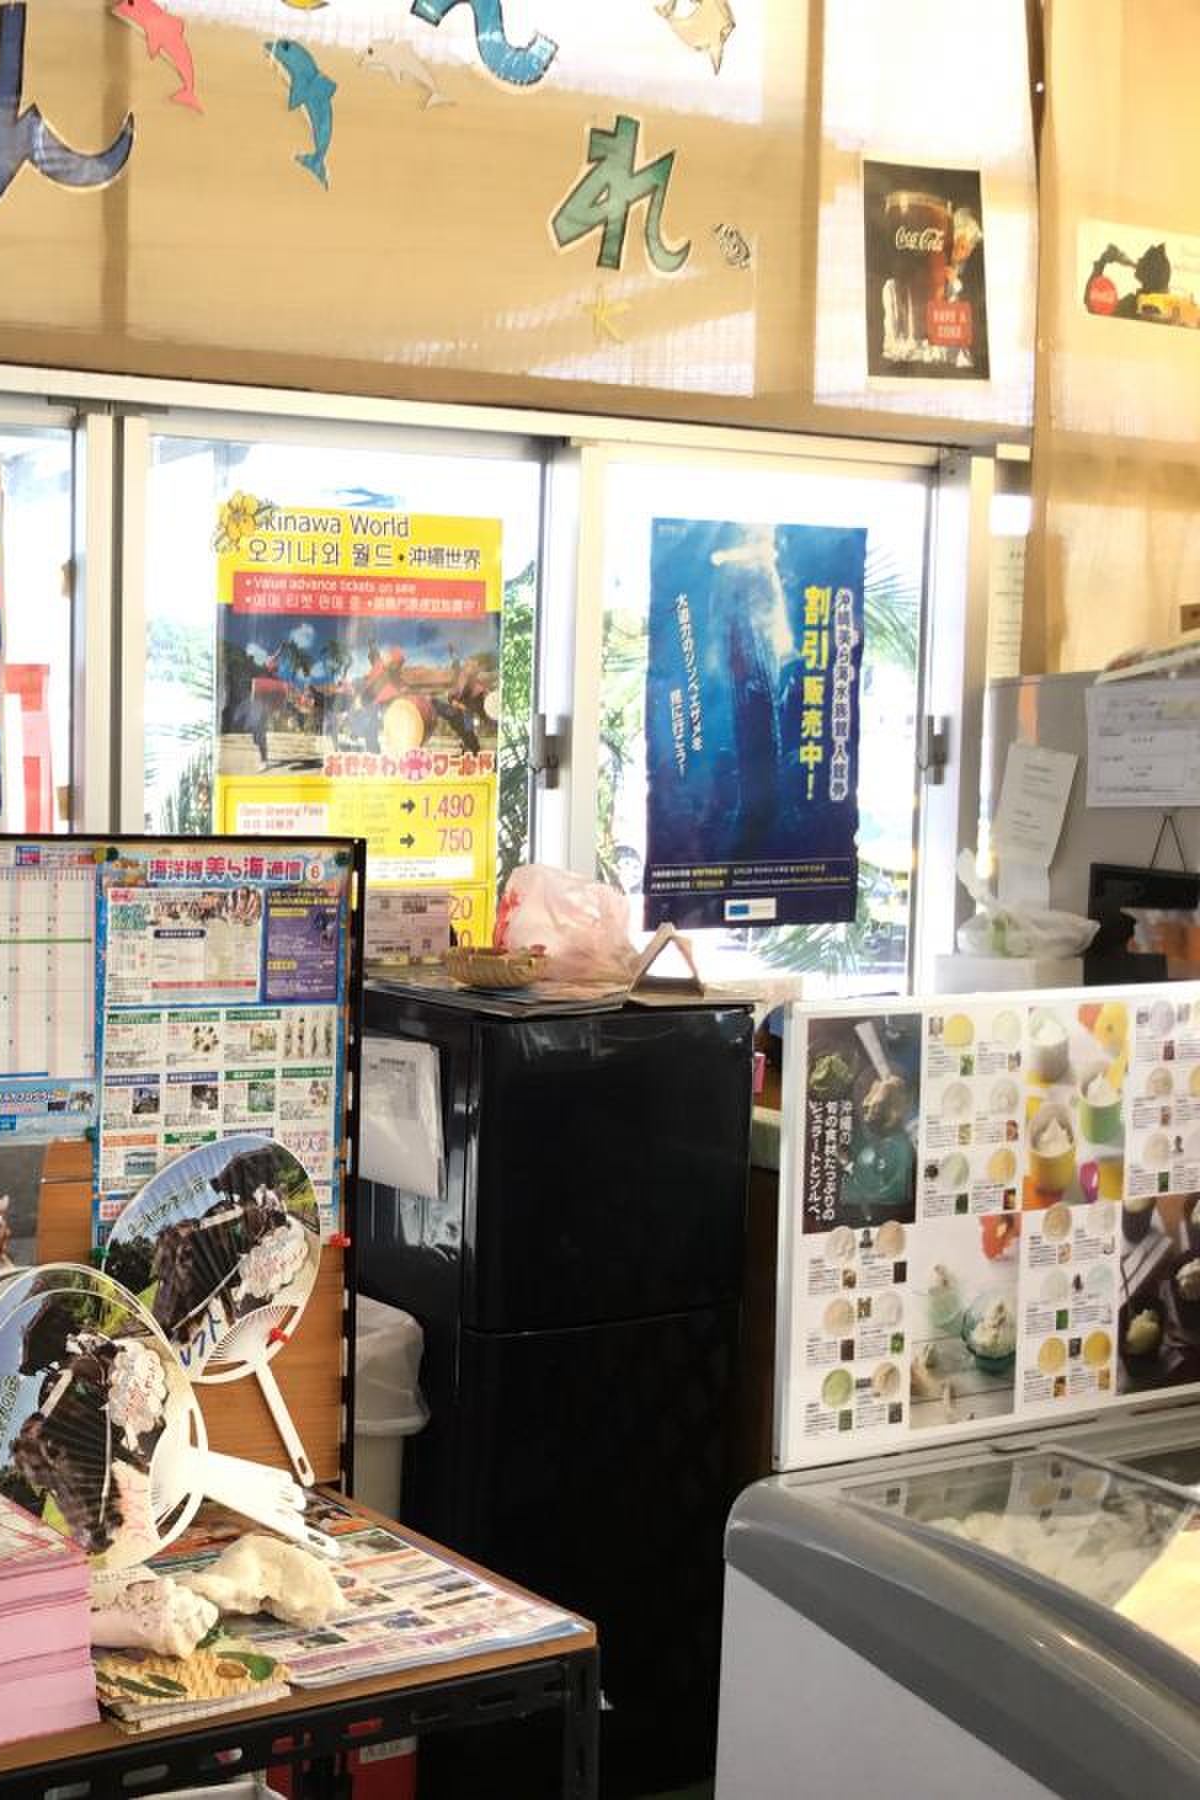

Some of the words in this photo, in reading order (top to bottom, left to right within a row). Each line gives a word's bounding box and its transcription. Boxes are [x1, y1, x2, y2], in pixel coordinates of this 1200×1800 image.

[550, 114, 692, 273] れ
[255, 514, 342, 535] kinawa
[350, 514, 410, 538] World
[249, 539, 340, 566] 오키나와
[421, 793, 475, 821] 1,490
[438, 828, 474, 851] 750
